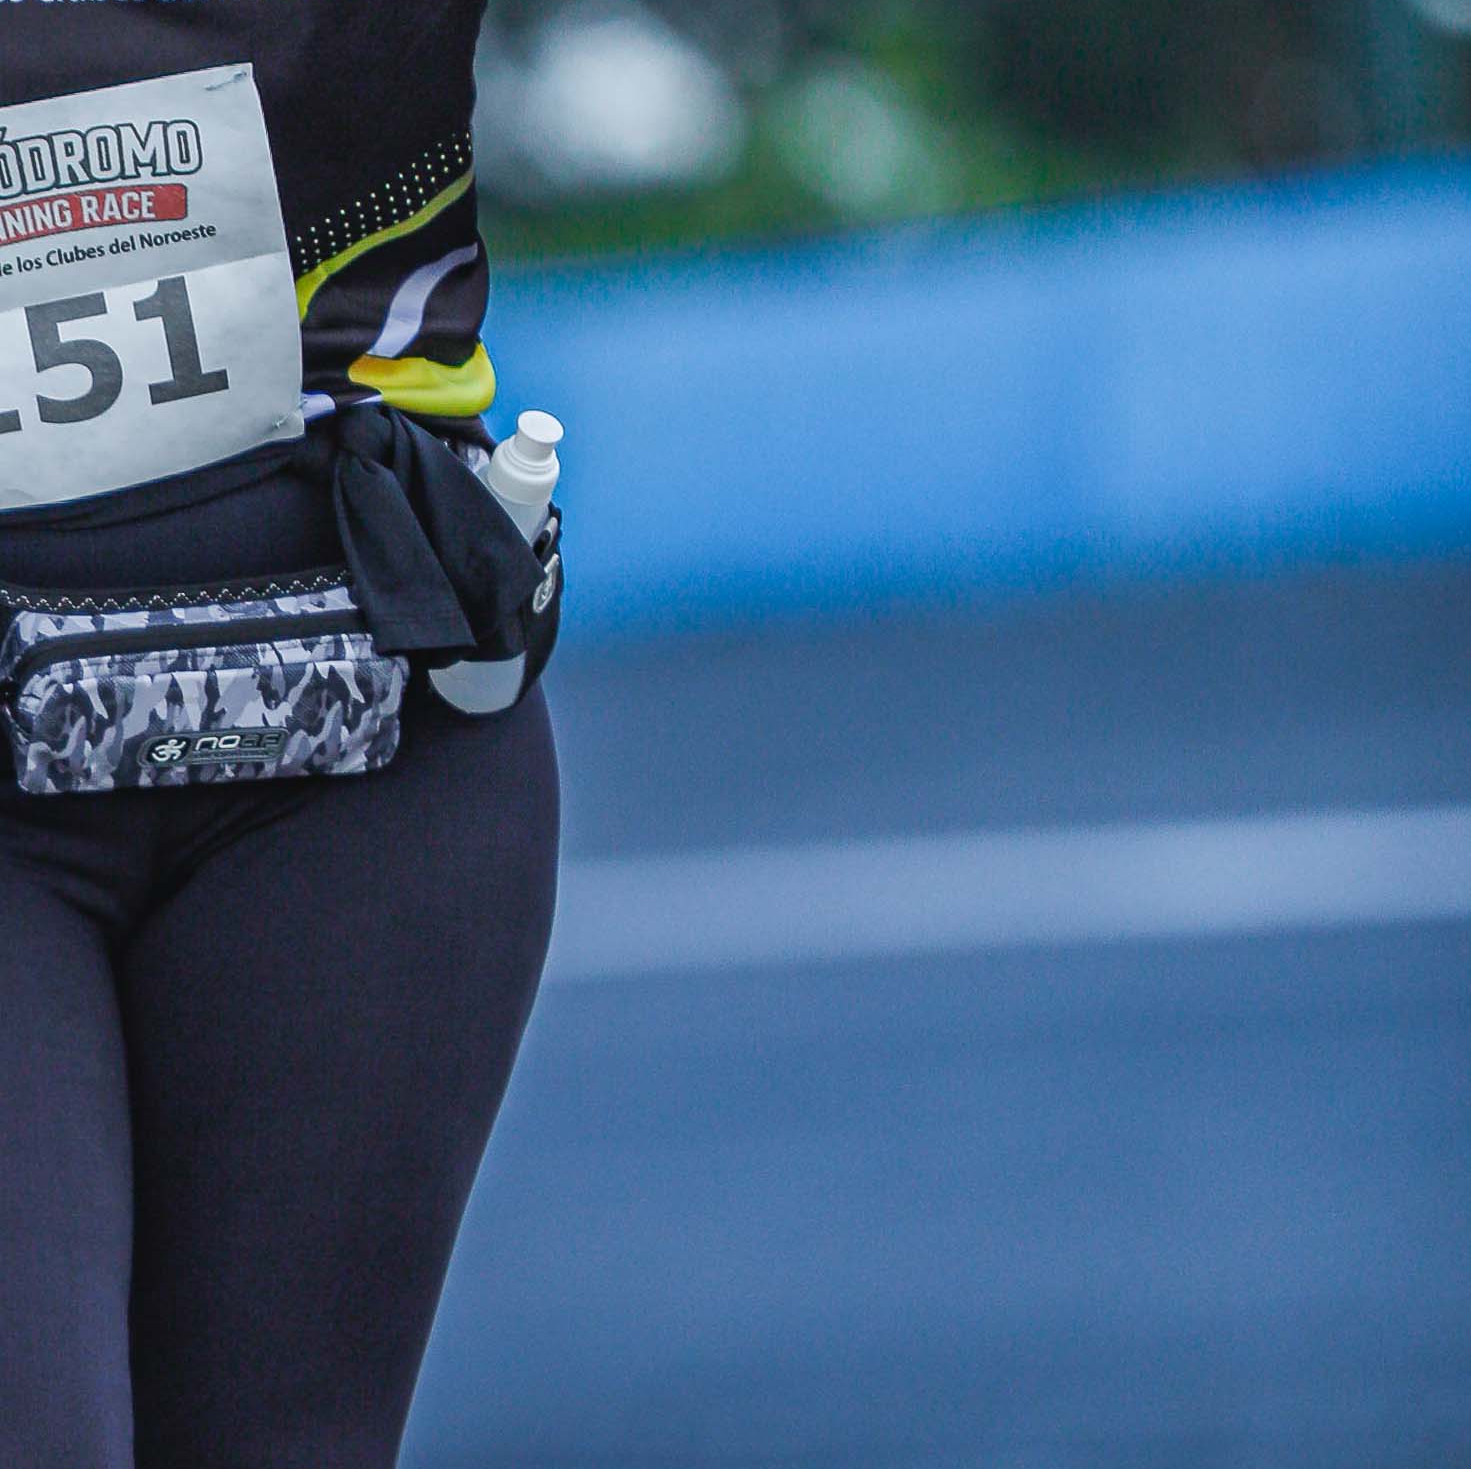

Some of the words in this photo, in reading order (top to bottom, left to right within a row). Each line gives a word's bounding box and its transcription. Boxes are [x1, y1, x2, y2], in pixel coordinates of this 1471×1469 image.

[81, 191, 156, 223] RACE
[16, 254, 43, 275] los
[46, 245, 106, 267] Clubes
[109, 236, 137, 256] del
[139, 223, 217, 250] Noroeste
